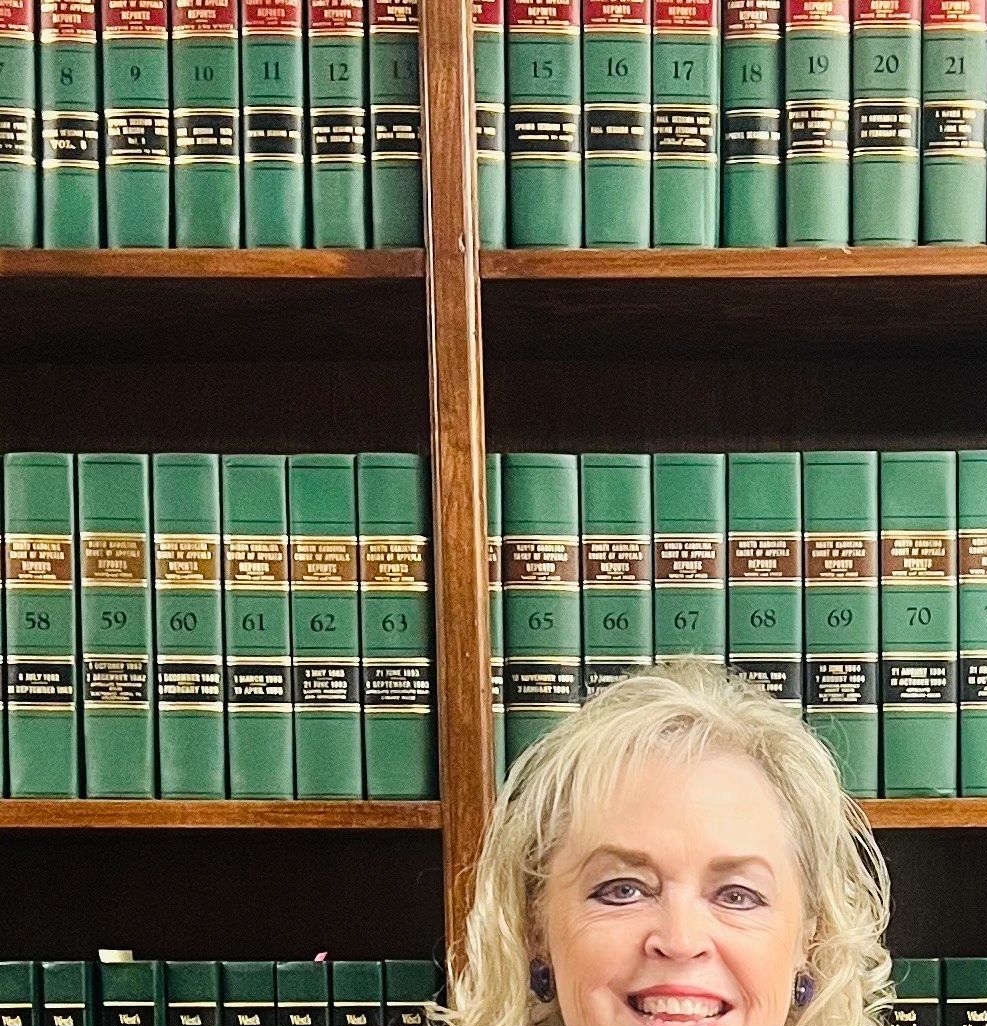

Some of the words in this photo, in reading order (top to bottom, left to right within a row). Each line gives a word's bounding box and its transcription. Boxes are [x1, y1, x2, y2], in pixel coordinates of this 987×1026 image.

[130, 65, 141, 82] 9
[194, 65, 214, 82] 10
[263, 61, 281, 81] 11
[329, 62, 349, 82] 12
[532, 60, 553, 79] 15
[607, 57, 629, 77] 16
[672, 60, 694, 81] 17
[808, 55, 829, 75] 19
[873, 54, 899, 74] 20
[944, 56, 965, 75] 21
[59, 67, 74, 87] 8
[740, 63, 762, 86] 18
[25, 611, 51, 631] 58
[101, 610, 127, 629] 59
[169, 611, 198, 632] 60
[242, 613, 265, 632] 61
[310, 613, 336, 633] 62
[381, 613, 408, 633] 63
[528, 611, 554, 631] 65
[602, 612, 629, 631] 66
[674, 610, 699, 630] 67
[750, 609, 776, 628] 68
[827, 609, 853, 628] 69
[906, 607, 932, 626] 70
